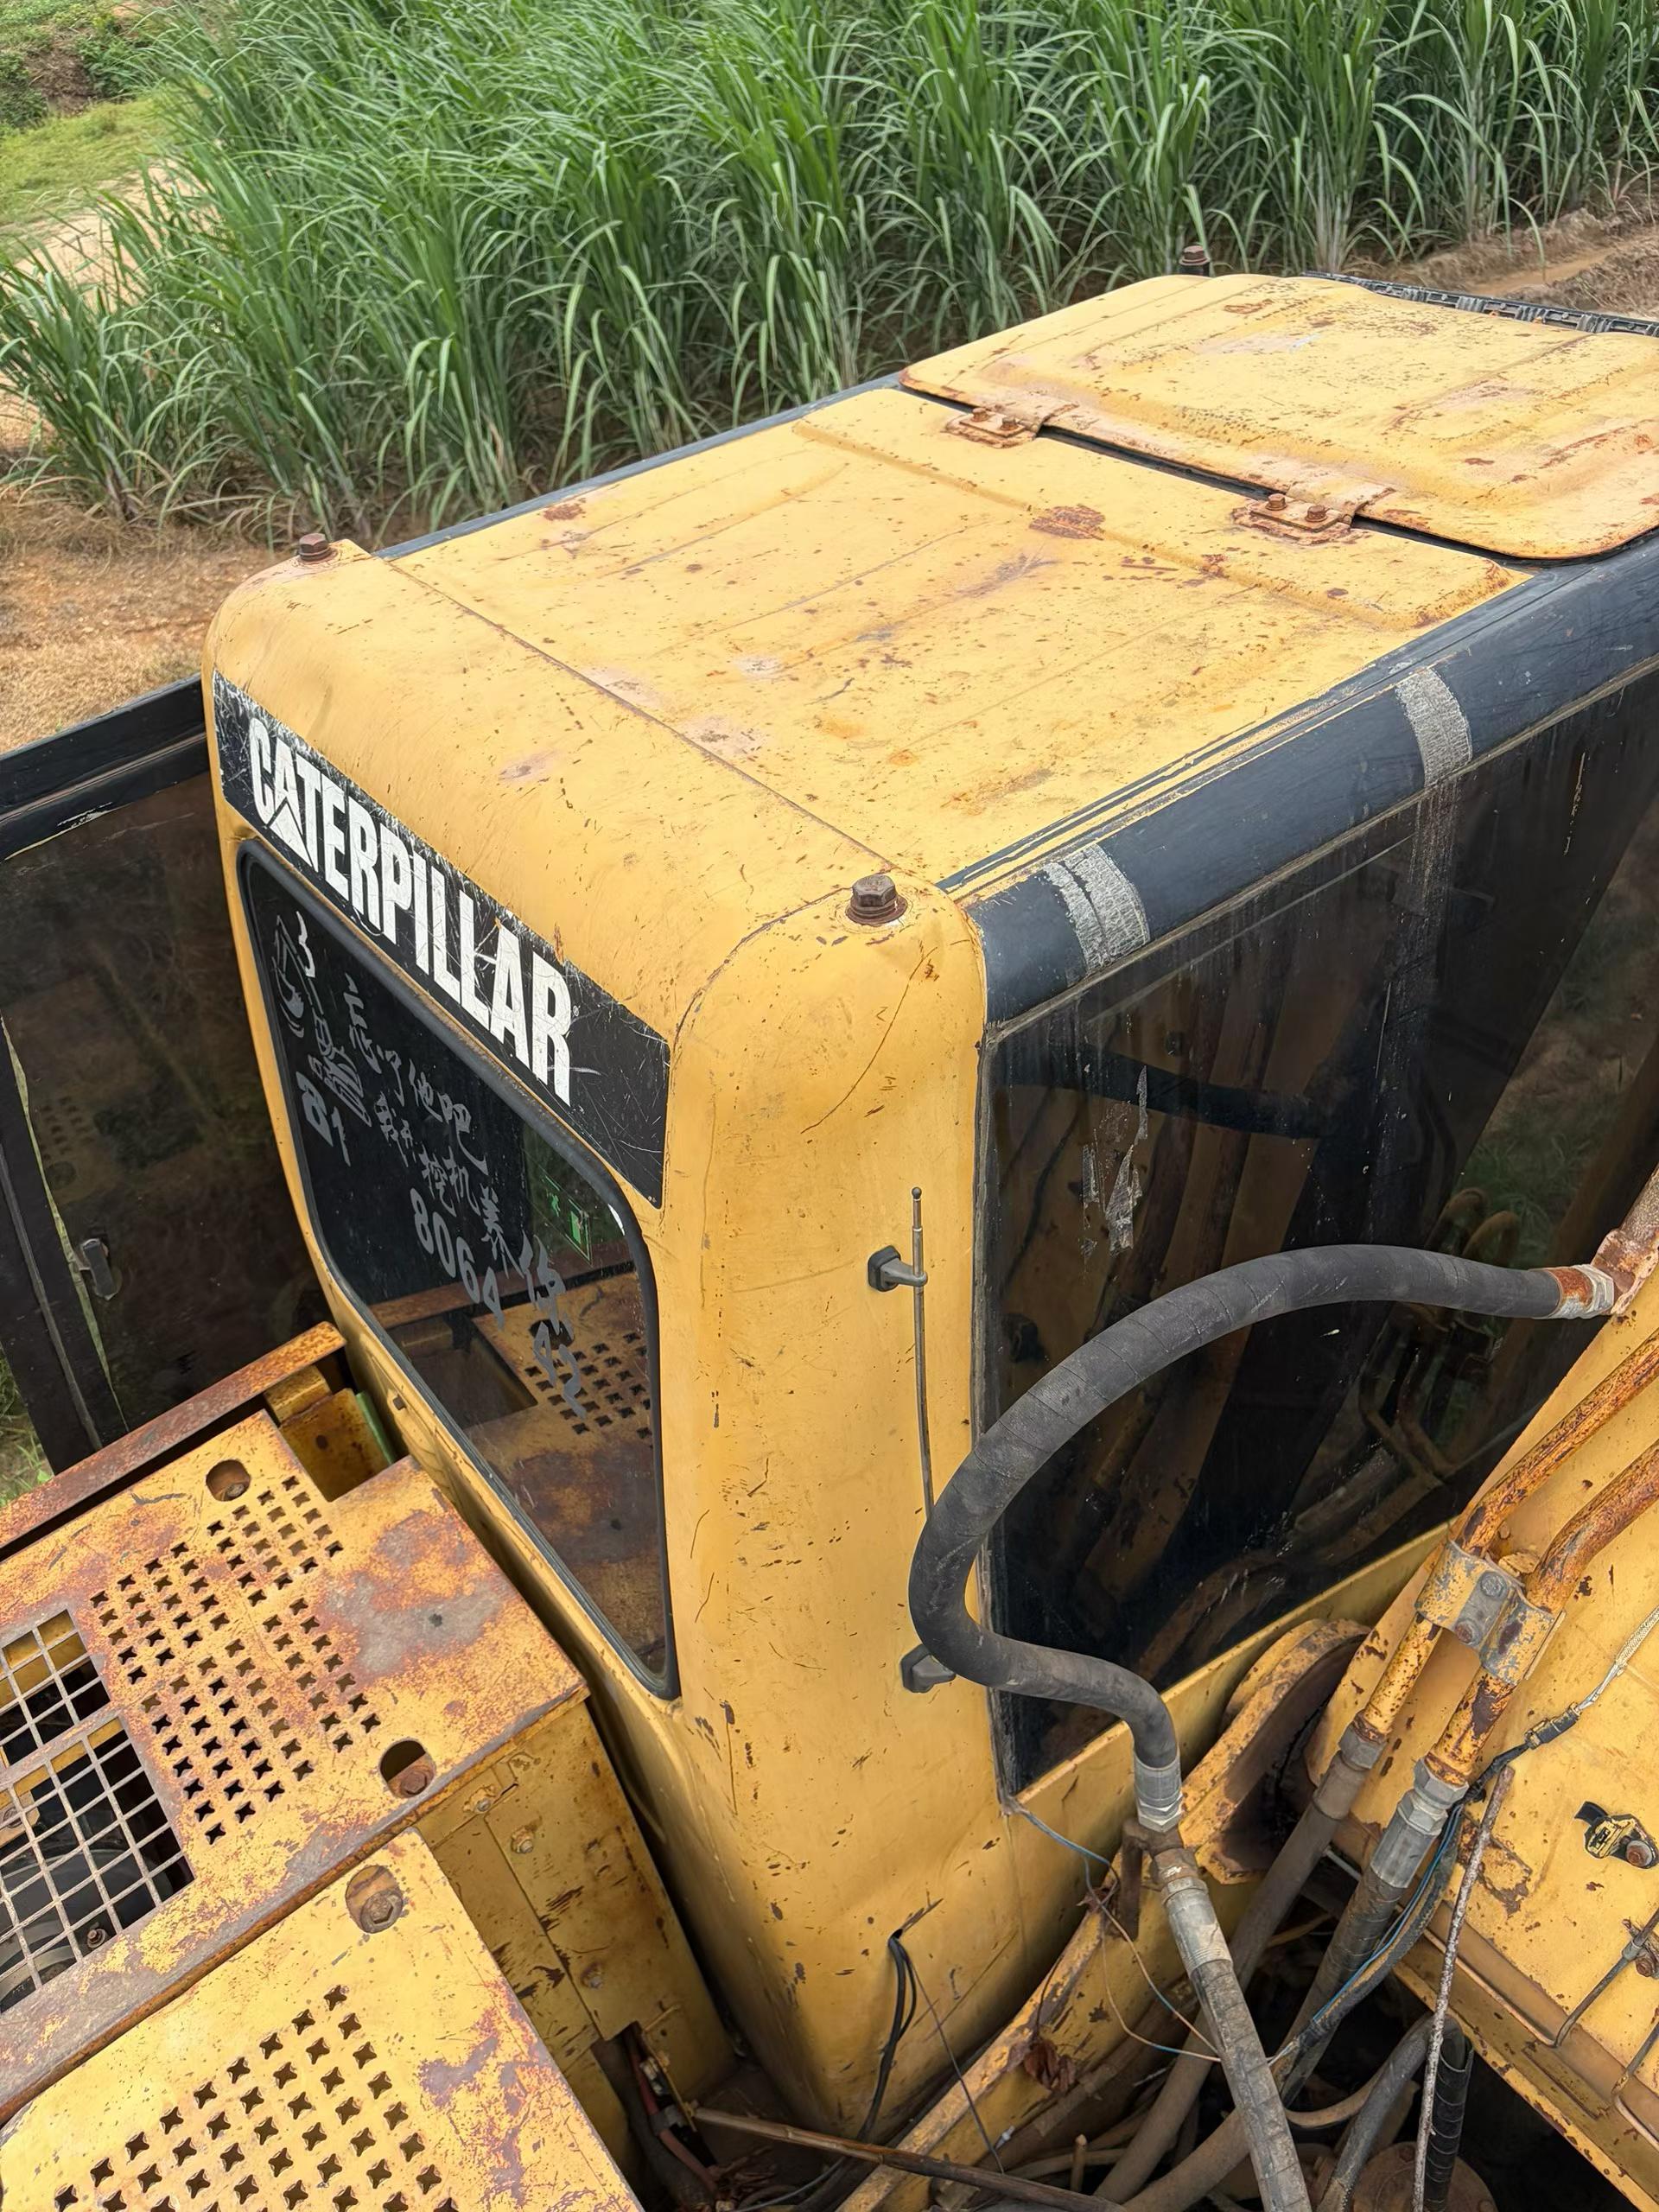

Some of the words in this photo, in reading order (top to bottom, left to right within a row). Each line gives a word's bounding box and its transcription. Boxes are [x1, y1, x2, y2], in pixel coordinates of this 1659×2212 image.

[249, 718, 571, 1107] CATERPILLAR
[344, 973, 489, 1176] 忘了他吧
[373, 1090, 574, 1342] 我开挖机养你
